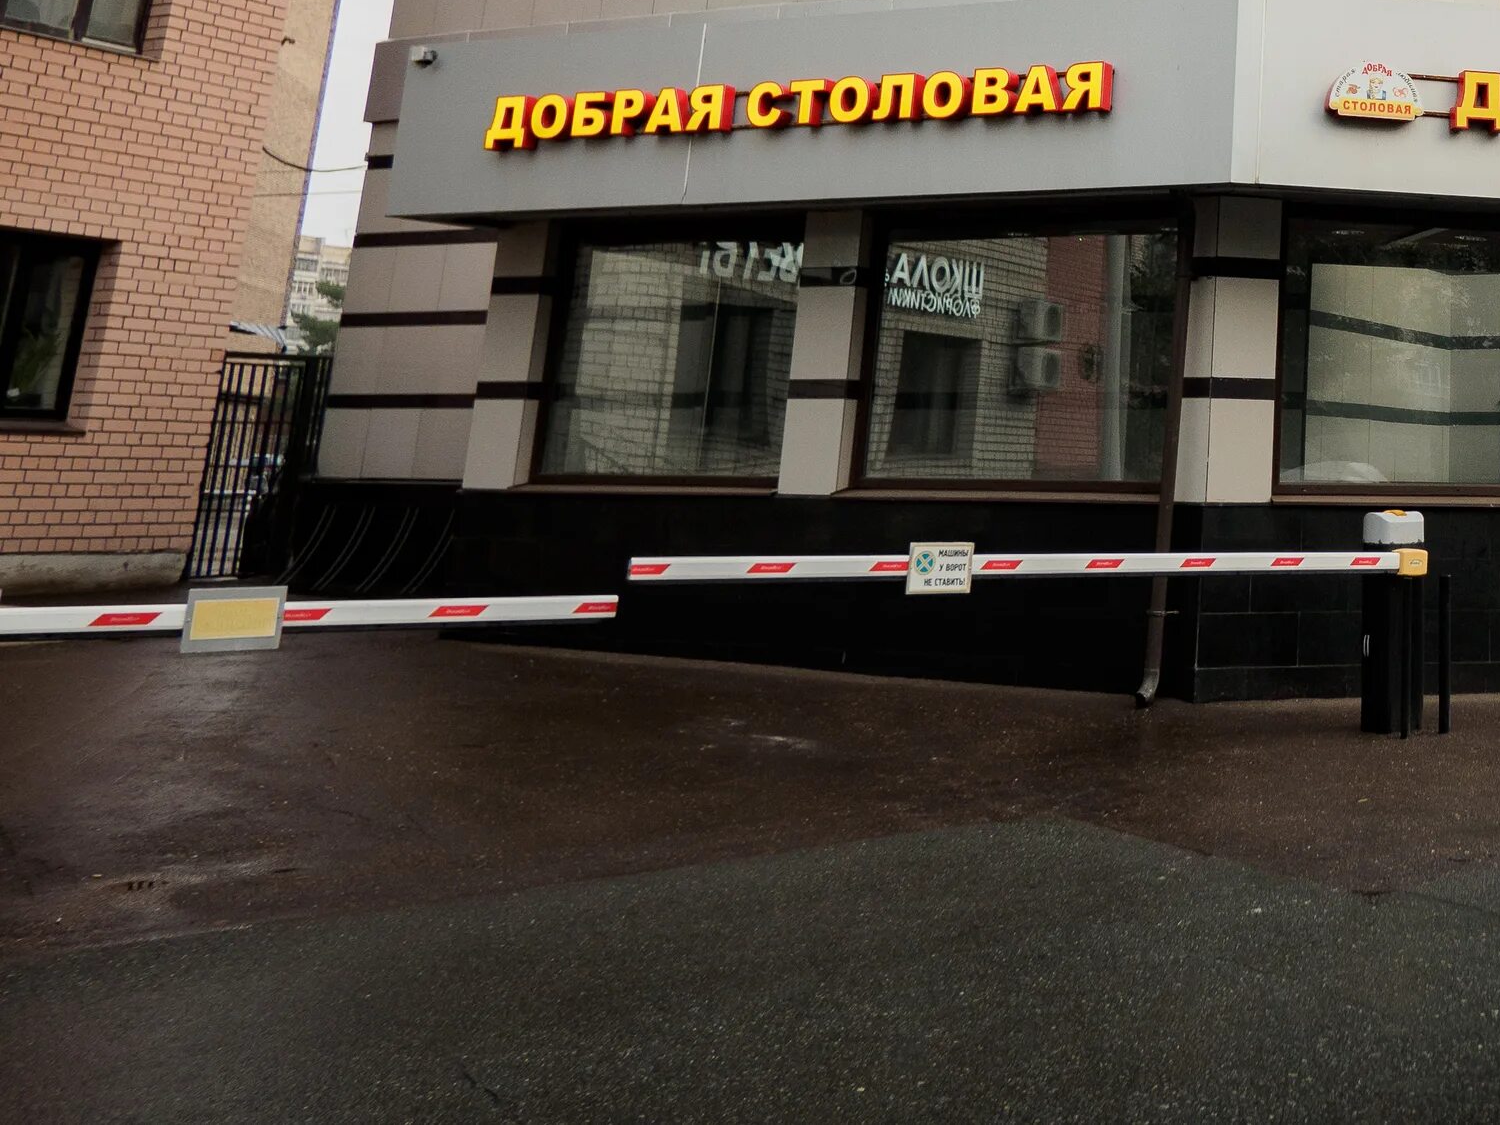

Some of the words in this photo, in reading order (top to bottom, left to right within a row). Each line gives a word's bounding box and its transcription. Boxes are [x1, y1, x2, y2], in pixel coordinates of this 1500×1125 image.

[1361, 63, 1393, 77] ДОБРАЯ
[484, 85, 734, 153] ДОБРАЯ
[745, 60, 1114, 129] СТОЛОВАЯ
[1343, 100, 1412, 115] СТОЛОВАЯ
[938, 549, 969, 557] МАШИНЫ
[938, 563, 944, 572] У
[945, 563, 966, 572] ВОРОТ
[924, 578, 932, 586] НЕ
[934, 577, 966, 586] СТАВИТЬ!
